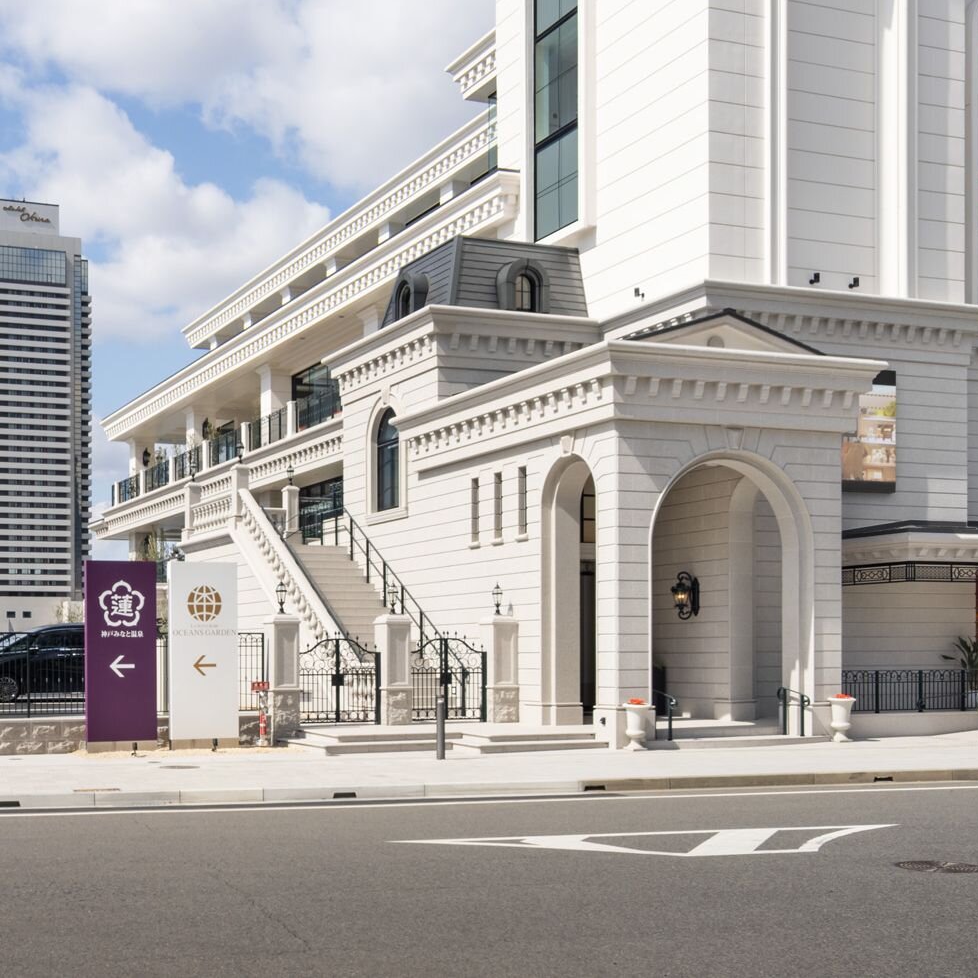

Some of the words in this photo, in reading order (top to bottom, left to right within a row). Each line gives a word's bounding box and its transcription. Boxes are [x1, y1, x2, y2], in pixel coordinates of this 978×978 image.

[110, 594, 134, 617] 蓮
[101, 630, 144, 638] 神戸みなと温泉
[172, 629, 204, 637] OCEANS
[205, 629, 237, 637] GARDEN
